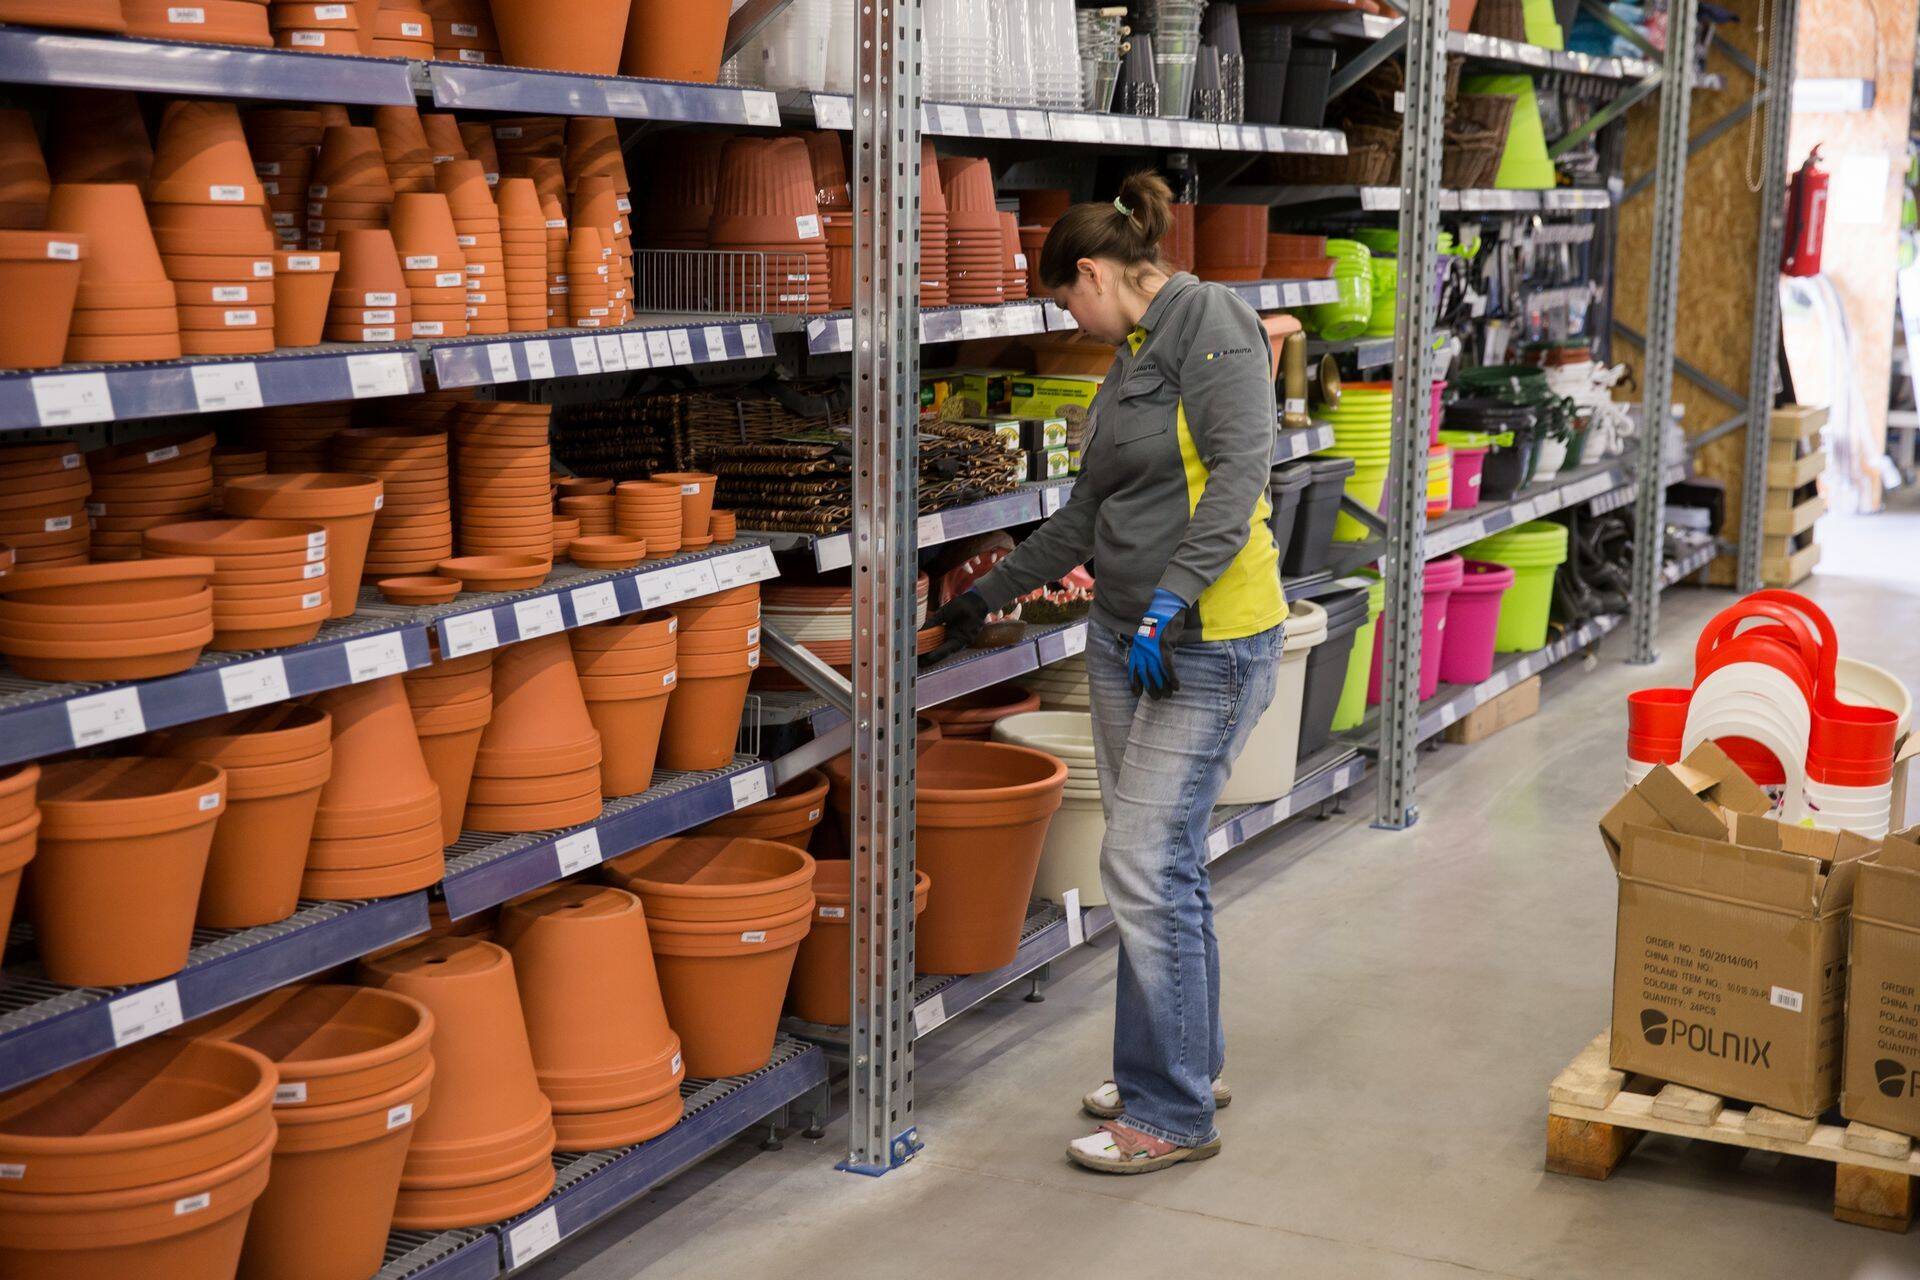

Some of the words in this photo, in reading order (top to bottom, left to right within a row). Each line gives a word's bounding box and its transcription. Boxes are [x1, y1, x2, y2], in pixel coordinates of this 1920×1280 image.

[1645, 935, 1674, 949] ORDER
[1645, 949, 1669, 961] CHINA
[1673, 956, 1694, 968] ITEM
[1643, 963, 1678, 978] POLAND
[1681, 971, 1702, 984] ITEM
[1643, 976, 1678, 991] COLOUR
[1682, 986, 1693, 996] OF
[1698, 991, 1721, 1003] POTS
[1881, 981, 1915, 997] ORDER
[1689, 1002, 1717, 1016] 24PCS
[1880, 995, 1909, 1010] CHINA
[1879, 1010, 1919, 1027] POLAND
[1878, 1024, 1918, 1042] COLOUR
[1671, 1019, 1771, 1069] POLNIX
